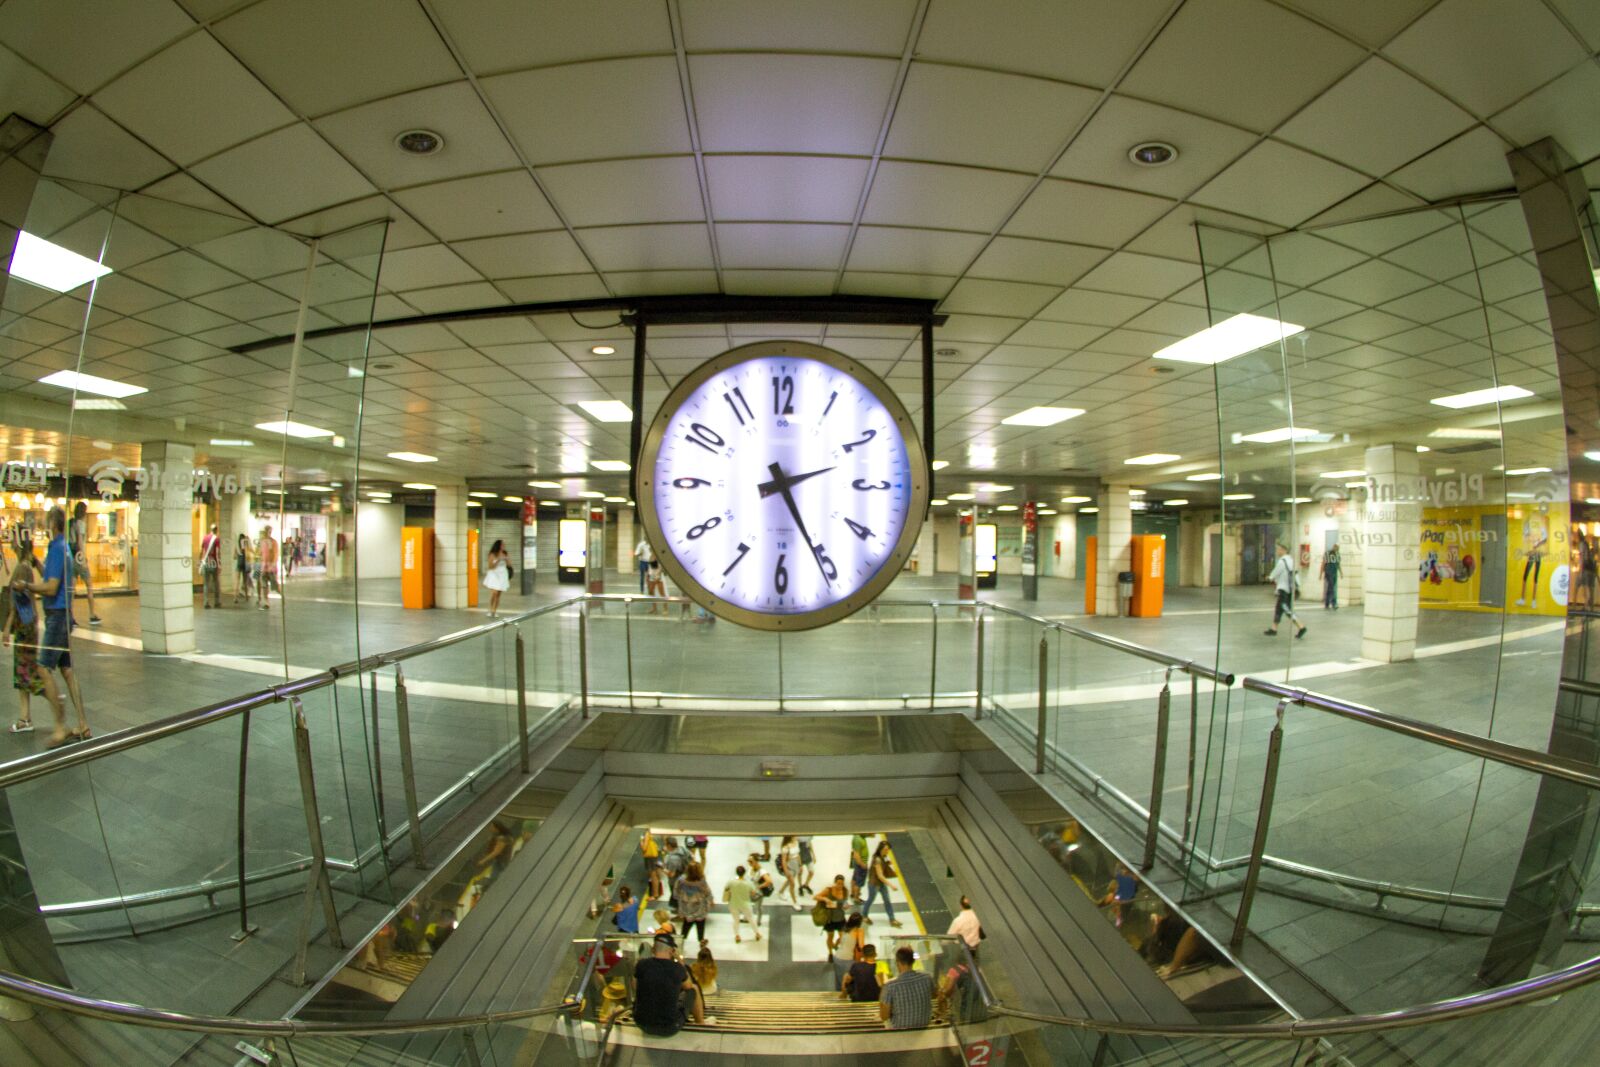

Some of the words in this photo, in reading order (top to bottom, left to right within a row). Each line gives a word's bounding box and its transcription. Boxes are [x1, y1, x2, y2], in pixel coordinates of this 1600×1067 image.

[723, 387, 755, 426] 11
[772, 375, 794, 415] 12
[823, 391, 838, 416] 1
[685, 422, 725, 455] 10
[842, 429, 877, 453] 2
[673, 477, 711, 489] 9
[852, 478, 891, 492] 3
[686, 516, 721, 540] 8
[843, 517, 876, 541] 4
[723, 542, 750, 577] 7
[813, 543, 838, 580] 5
[774, 554, 788, 595] 6
[970, 1045, 990, 1066] 2
